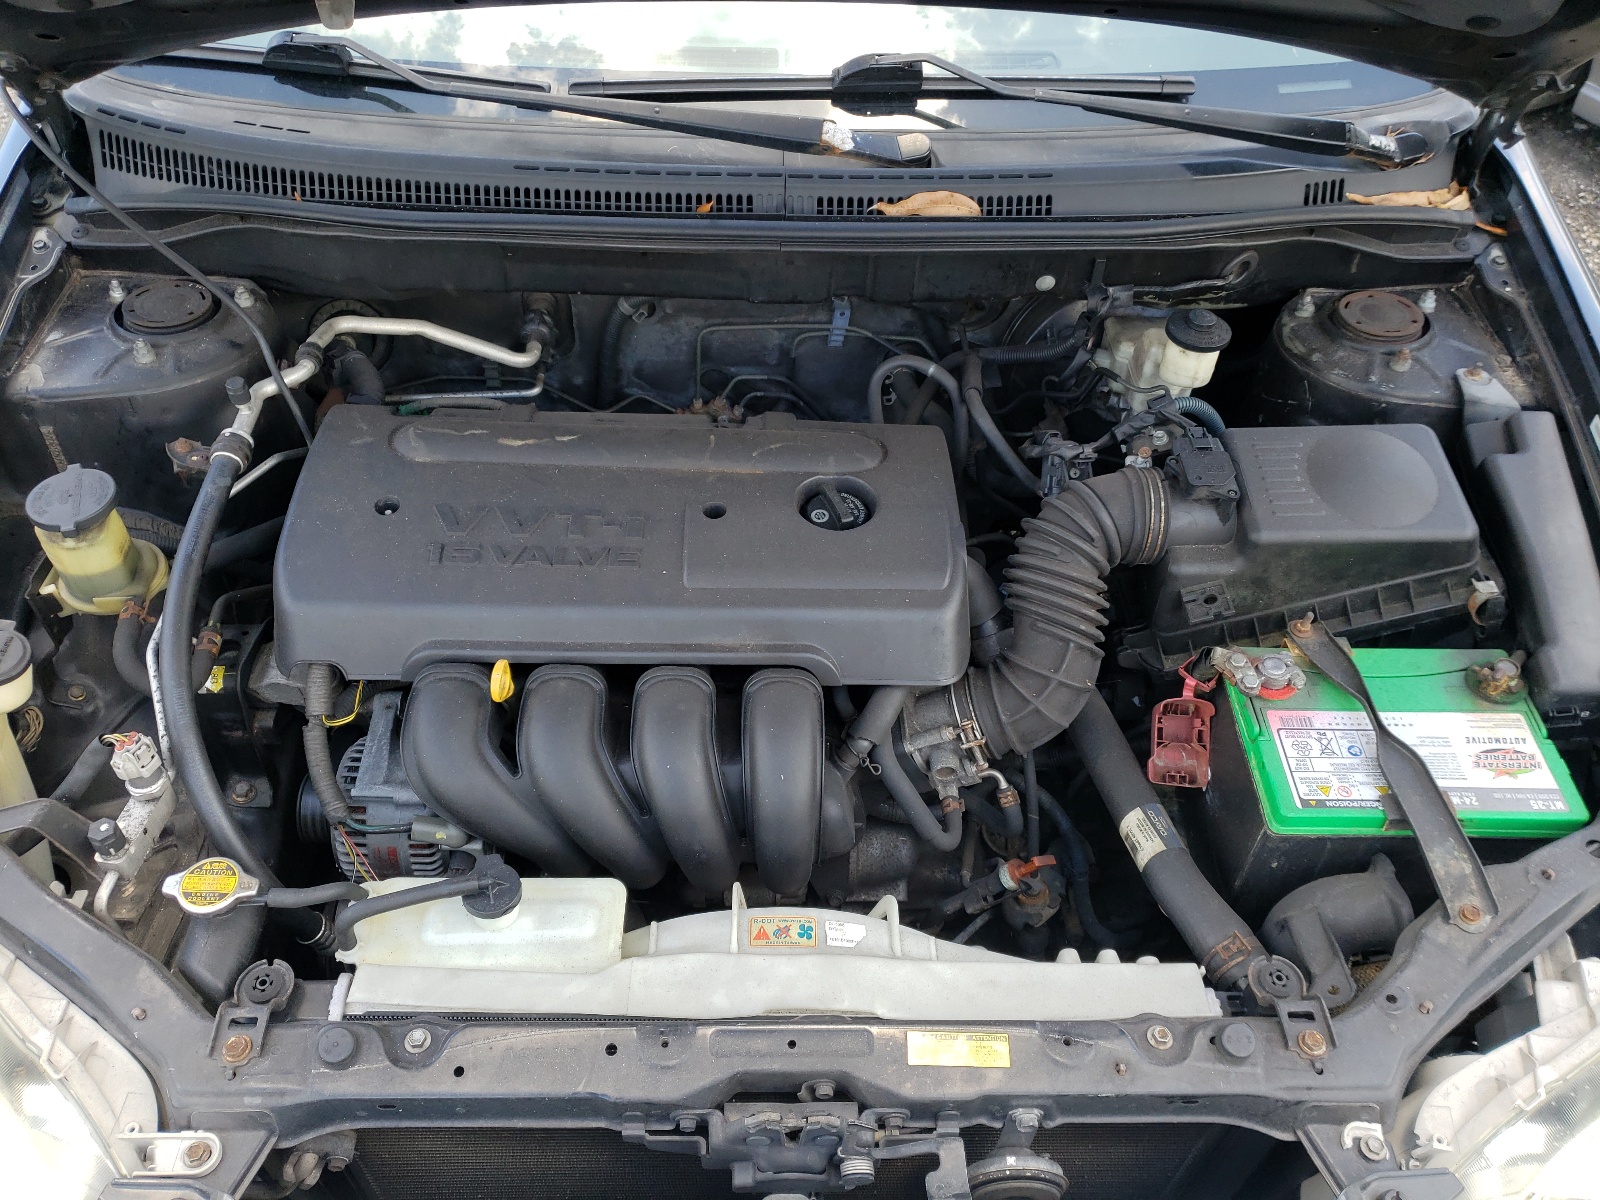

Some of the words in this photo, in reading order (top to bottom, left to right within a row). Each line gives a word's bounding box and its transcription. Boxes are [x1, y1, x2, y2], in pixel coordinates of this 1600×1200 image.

[488, 545, 642, 567] VALVE
[1465, 737, 1526, 745] AUTOMOTIVE
[1473, 761, 1542, 769] INTERSTATE
[1451, 796, 1480, 805] 24-M
[1530, 800, 1565, 810] MT-35
[1147, 810, 1168, 837] DAYCO
[193, 868, 233, 876] CAUTION
